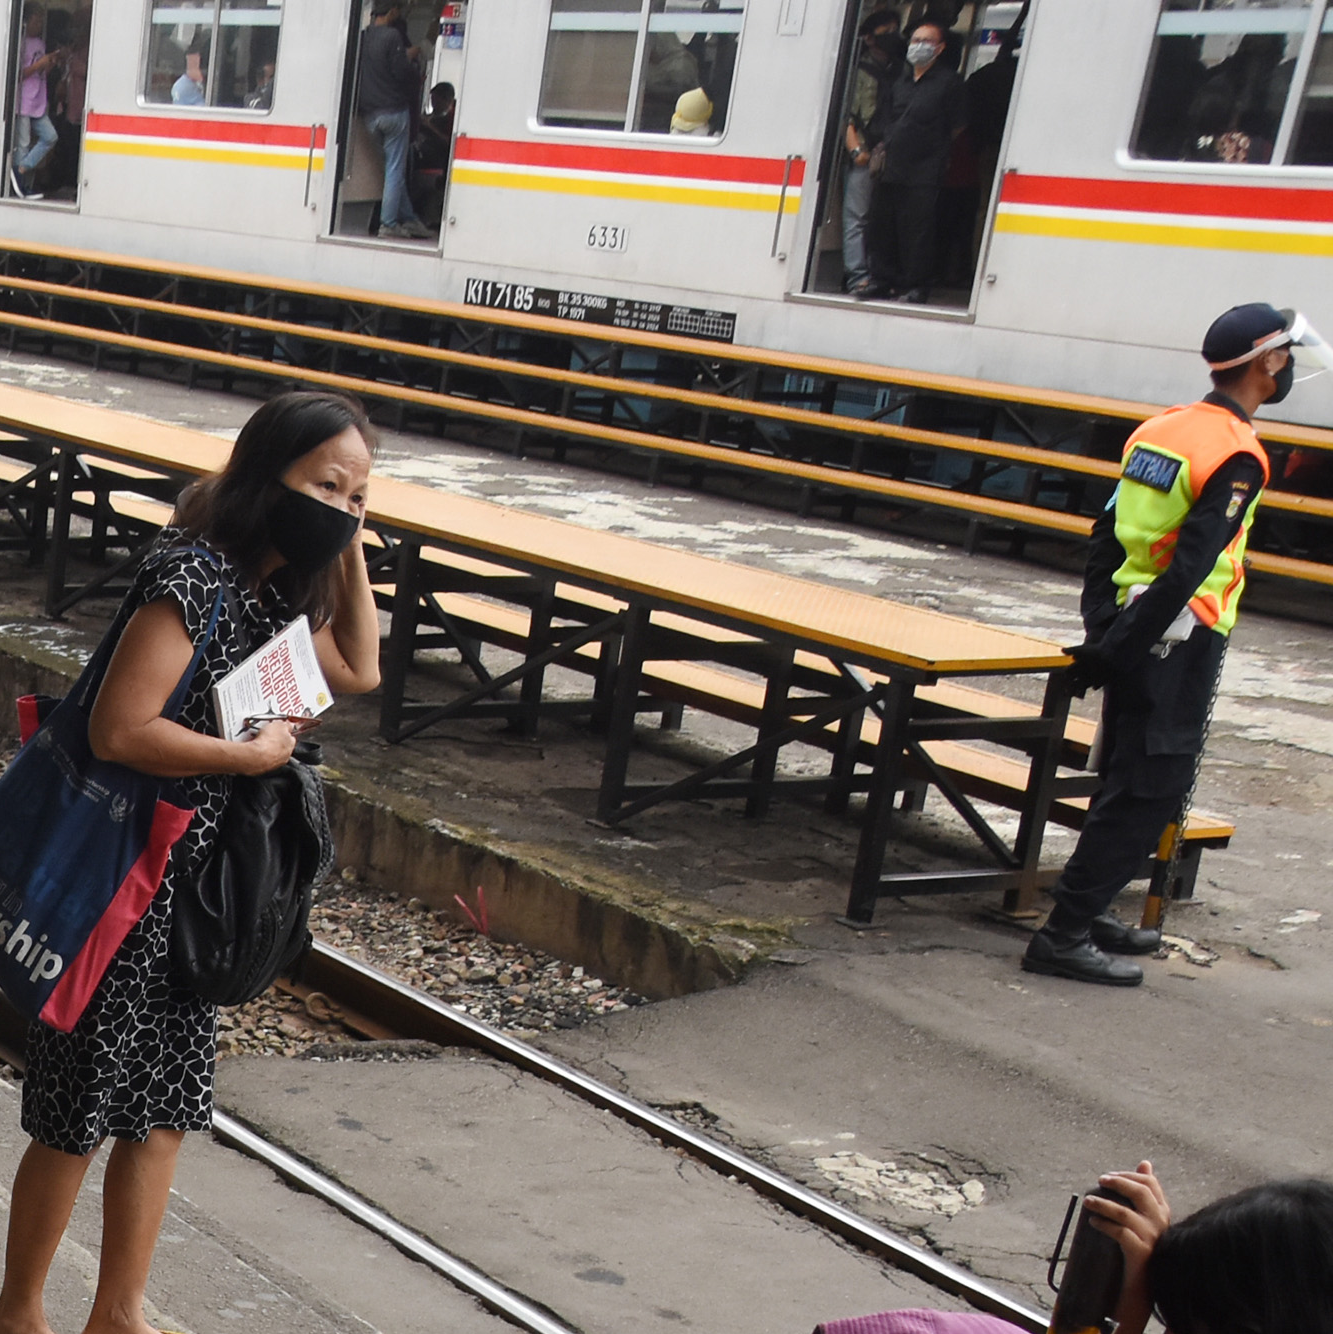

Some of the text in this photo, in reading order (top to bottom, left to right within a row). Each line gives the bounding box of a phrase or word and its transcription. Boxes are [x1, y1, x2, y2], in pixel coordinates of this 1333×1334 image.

[587, 225, 625, 250] 6331
[1125, 449, 1178, 489] SATPAM
[256, 655, 275, 701] SPIRIT
[278, 639, 305, 715] CONQUERING
